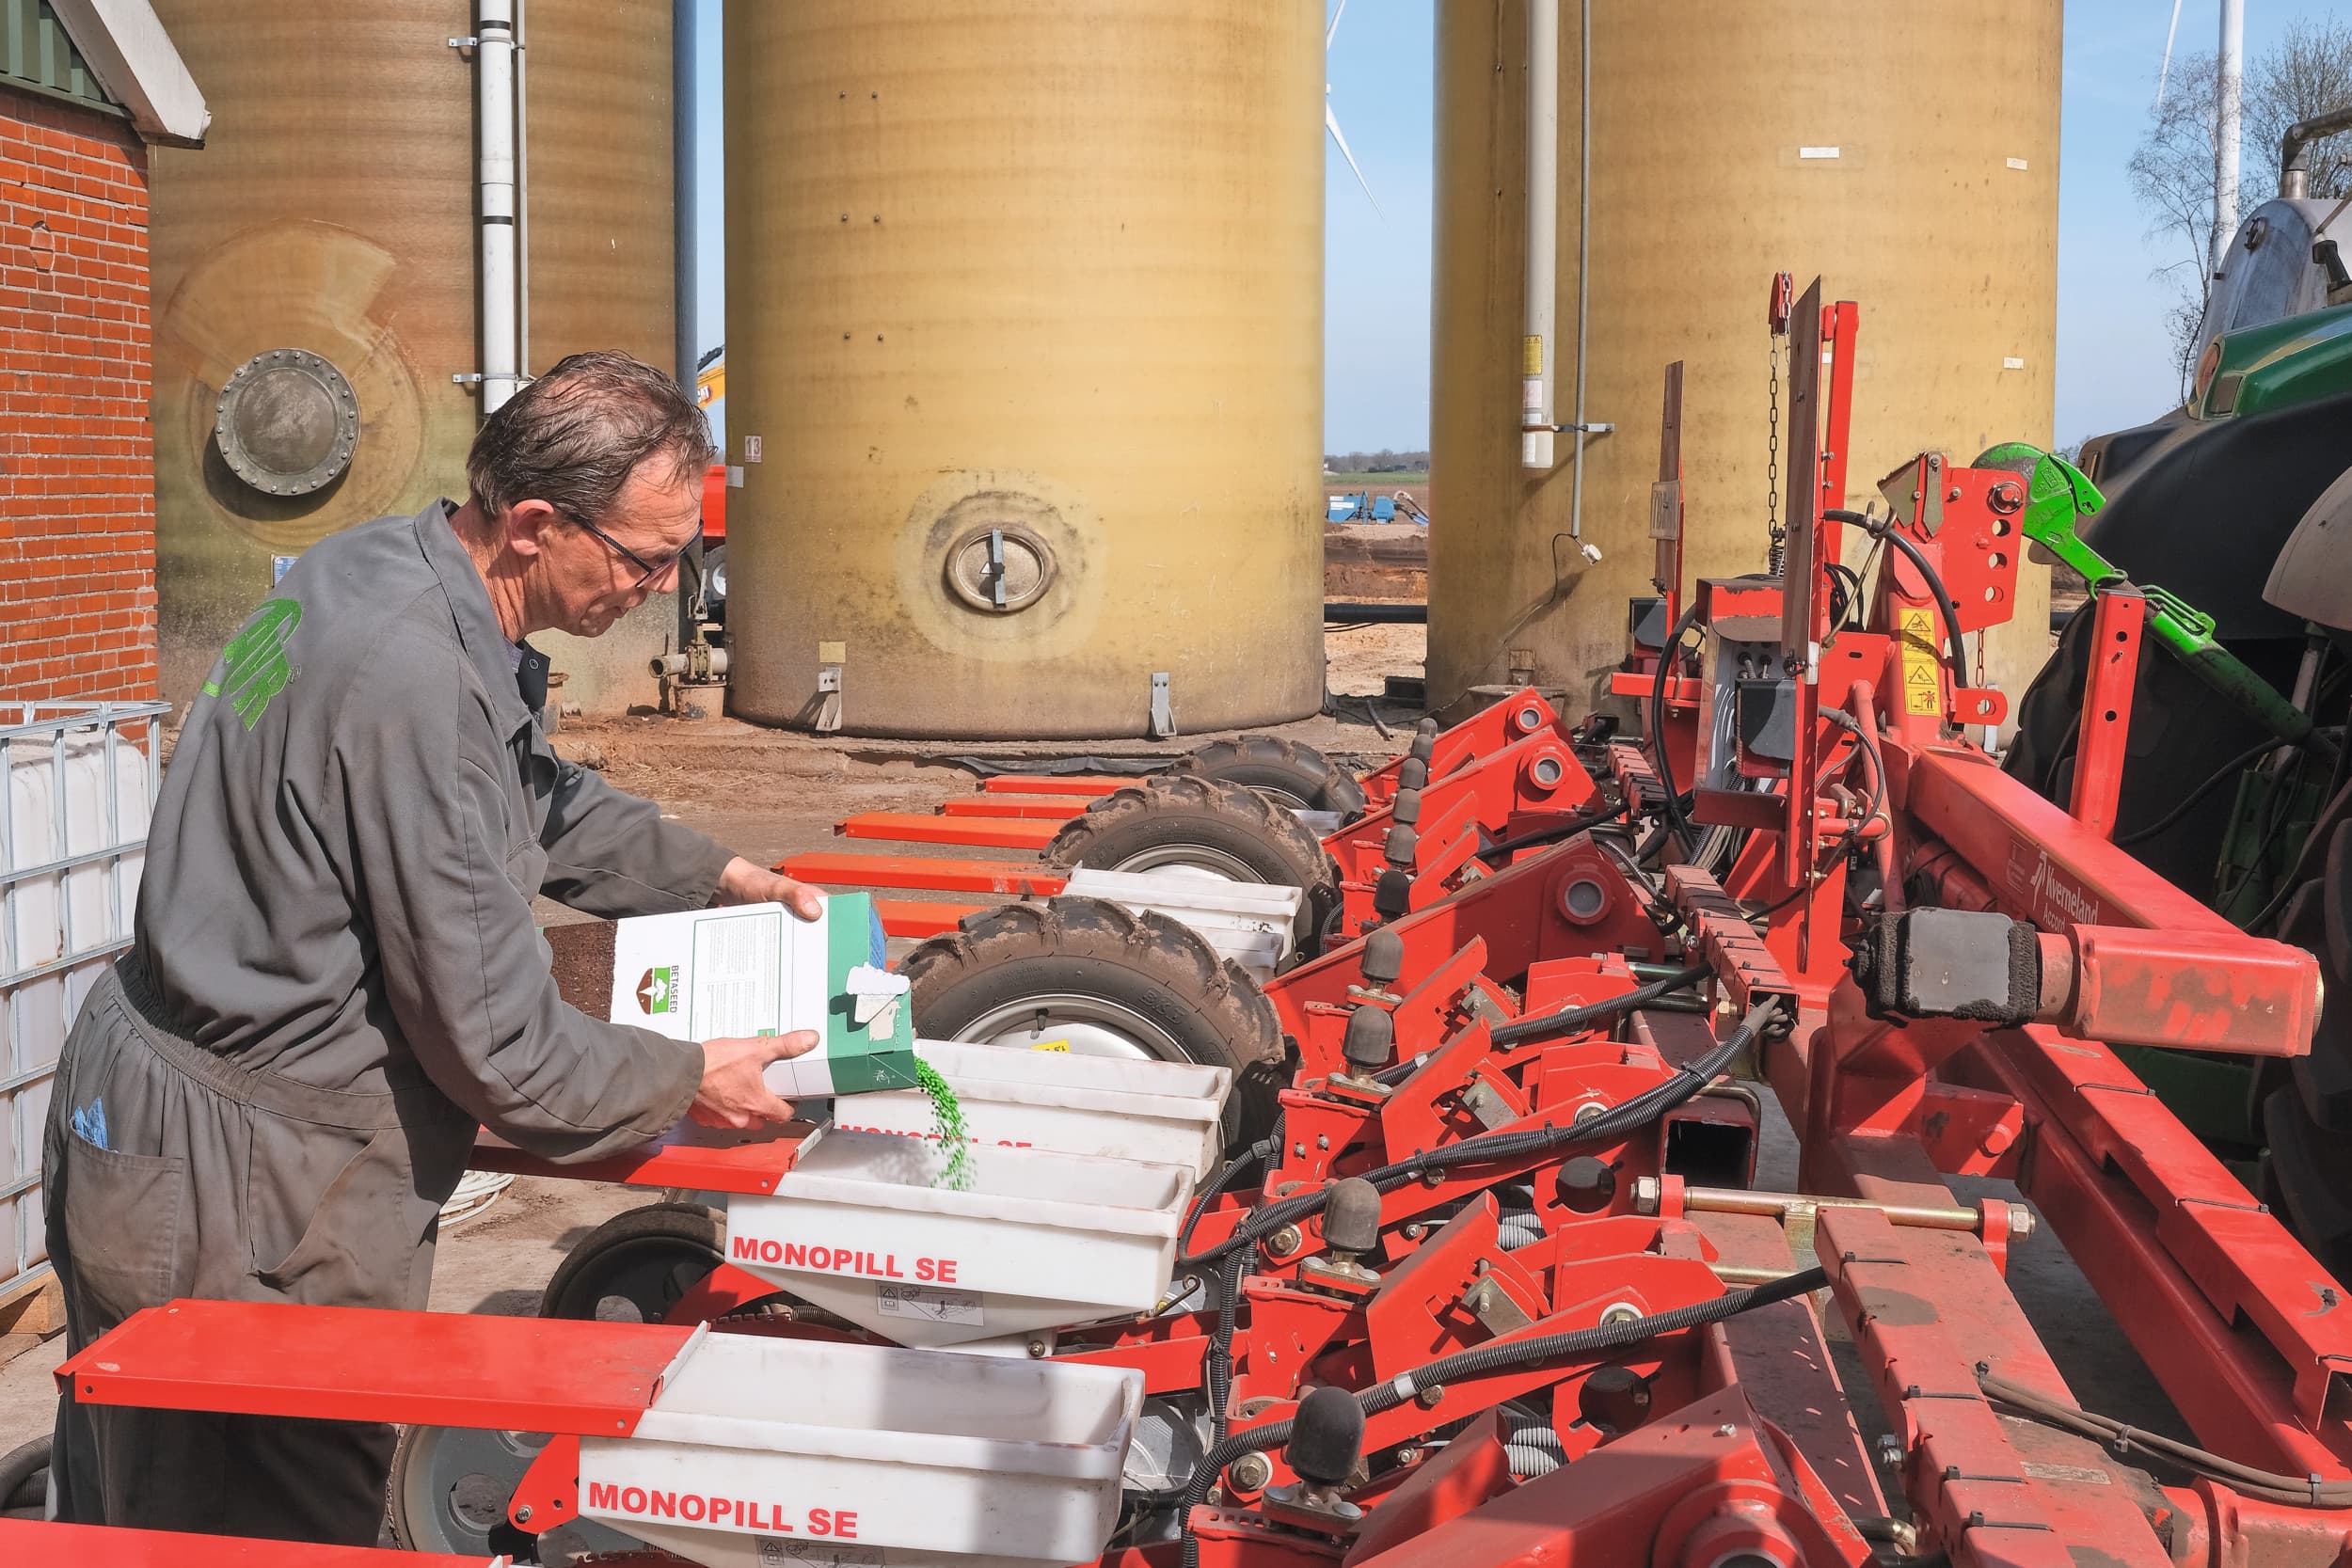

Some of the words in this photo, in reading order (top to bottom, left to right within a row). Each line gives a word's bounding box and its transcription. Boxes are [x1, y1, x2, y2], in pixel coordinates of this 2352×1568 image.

[746, 436, 760, 454] 13
[2042, 903, 2066, 934] Accord
[2045, 864, 2099, 926] Kverneland
[670, 965, 679, 1013] BETASEED
[733, 1236, 903, 1277] MONOPILL
[915, 1257, 957, 1283] SE
[589, 1481, 793, 1532] MONOPILL
[807, 1507, 858, 1538] SE
